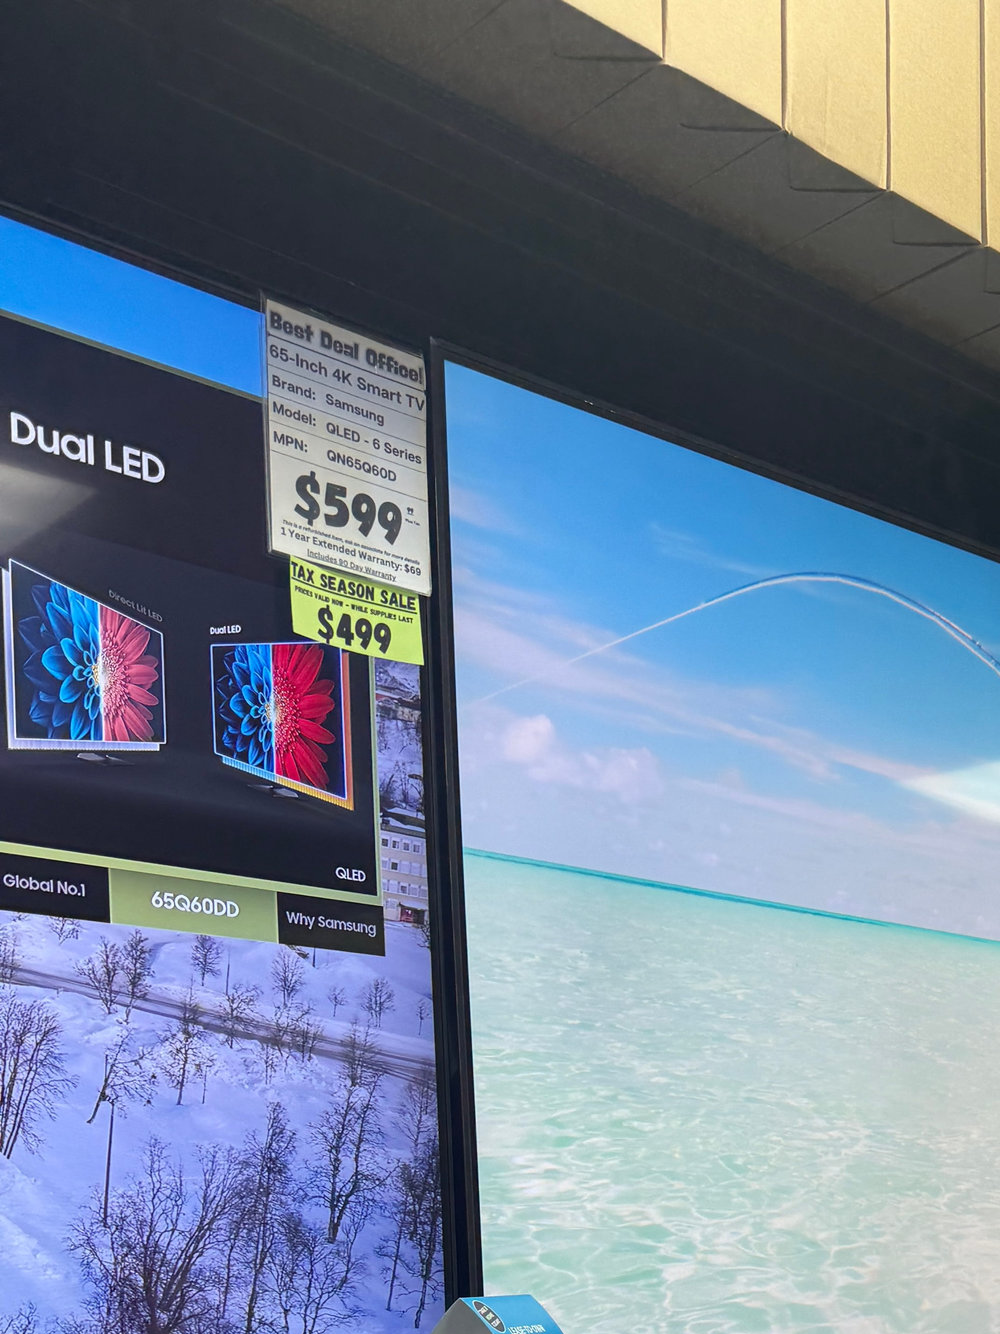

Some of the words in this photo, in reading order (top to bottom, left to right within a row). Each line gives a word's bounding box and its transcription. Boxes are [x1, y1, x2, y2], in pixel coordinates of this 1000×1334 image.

[270, 311, 314, 343] Best
[320, 330, 359, 361] Deal
[269, 344, 328, 378] 65-Inch
[332, 369, 352, 387] 4K
[357, 377, 402, 405] Smart
[405, 393, 425, 411] TV
[272, 375, 316, 401] Brand:
[325, 393, 385, 427] Samsung
[10, 411, 95, 466] Dual
[104, 441, 166, 484] LED
[272, 401, 316, 427] Model:
[326, 422, 361, 444] QLED
[373, 439, 381, 451] 6
[384, 442, 422, 465] Series
[273, 431, 308, 453] MPN:
[326, 449, 397, 482] QN65Q60D
[294, 470, 403, 546] $599
[281, 527, 286, 536] 1
[288, 528, 310, 543] Year
[312, 536, 356, 558] Extended
[358, 549, 403, 572] Warranty:
[404, 563, 421, 576] $69
[307, 549, 337, 564] Includes
[350, 561, 364, 573] Day
[364, 565, 397, 581] Warranty
[291, 561, 315, 584] TAX
[319, 573, 375, 602] SEASON
[380, 589, 416, 611] SALE
[136, 602, 147, 616] Lit
[147, 608, 163, 623] LED
[210, 626, 227, 635] Dual
[227, 624, 242, 634] LED
[317, 604, 392, 654] $499
[398, 614, 414, 625] LAST
[2, 873, 54, 894] Global
[57, 878, 86, 898] No.1
[335, 866, 366, 883] QLED
[151, 890, 240, 919] 65Q60DD
[286, 910, 314, 931] Why
[317, 912, 378, 938] Samsung
